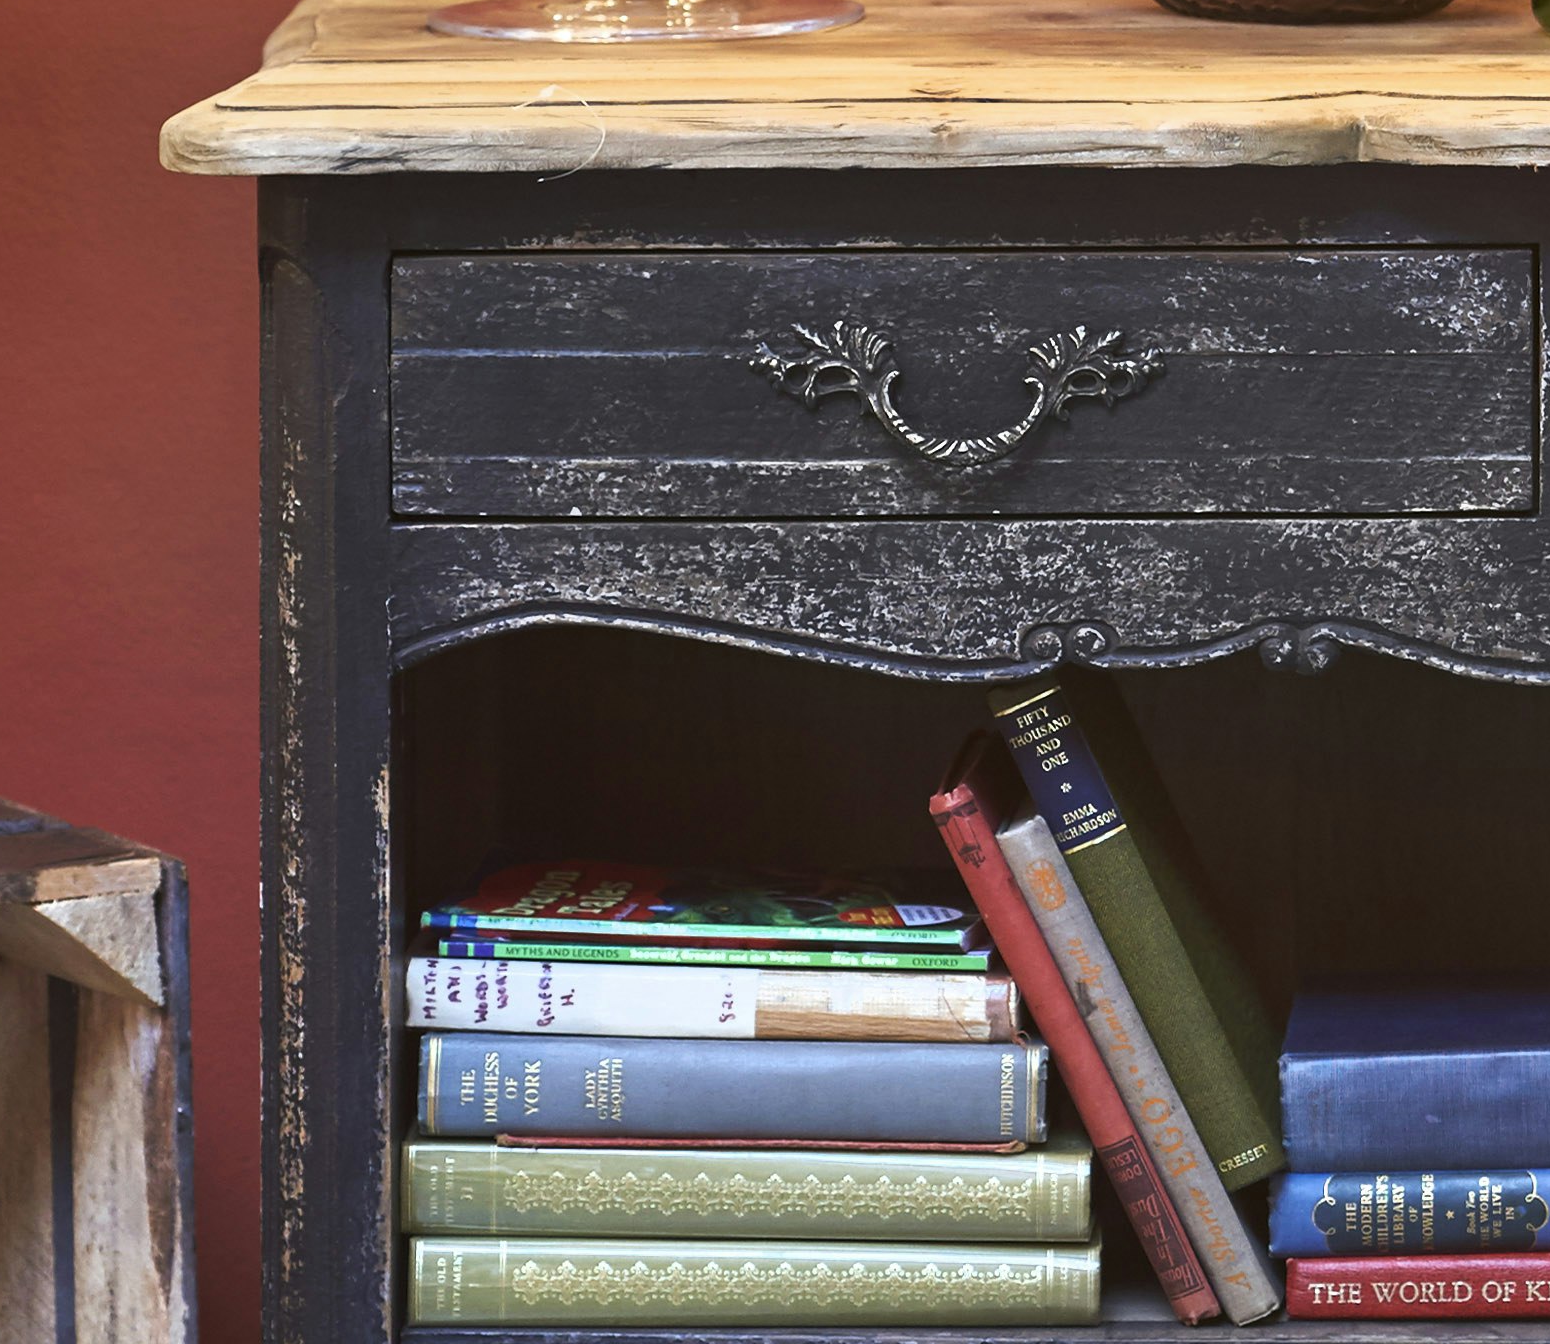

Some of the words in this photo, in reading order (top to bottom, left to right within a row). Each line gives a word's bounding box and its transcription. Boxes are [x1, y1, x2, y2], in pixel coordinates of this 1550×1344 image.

[1009, 713, 1072, 749] THOUSAND
[1016, 705, 1049, 729] FIFTY
[1036, 737, 1062, 757] AND
[1041, 751, 1070, 773] ONE
[1062, 803, 1098, 826] EMMA
[505, 946, 544, 958] MYTHS
[545, 947, 570, 959] AND
[572, 948, 620, 960] LEGENDS
[912, 956, 959, 968] OXFORD
[1098, 999, 1138, 1056] James
[460, 1068, 476, 1106] THE
[483, 1050, 501, 1123] DUCHESS
[505, 1076, 519, 1099] OF
[523, 1059, 542, 1117] YORK
[584, 1069, 597, 1109] LADY
[598, 1057, 610, 1120] CYNTHIA
[610, 1058, 624, 1123] ASQUITH
[1000, 1052, 1015, 1136] HUTCHINSON
[1140, 1096, 1199, 1180] EGO
[1218, 1143, 1269, 1174] CRESSET
[1360, 1183, 1374, 1247] MODERN
[1392, 1182, 1405, 1244] LIBRARY
[1408, 1205, 1418, 1223] OF
[1479, 1175, 1490, 1224] WORLD
[1491, 1184, 1502, 1216] LIVE
[1505, 1206, 1515, 1221] IN
[1189, 1185, 1236, 1264] Shorter
[1345, 1201, 1357, 1232] THE
[1492, 1220, 1503, 1240] WE
[436, 1256, 447, 1284] OLD
[1226, 1270, 1253, 1292] A
[1307, 1283, 1362, 1305] THE
[1370, 1280, 1473, 1304] WORLD
[1481, 1280, 1517, 1303] OF
